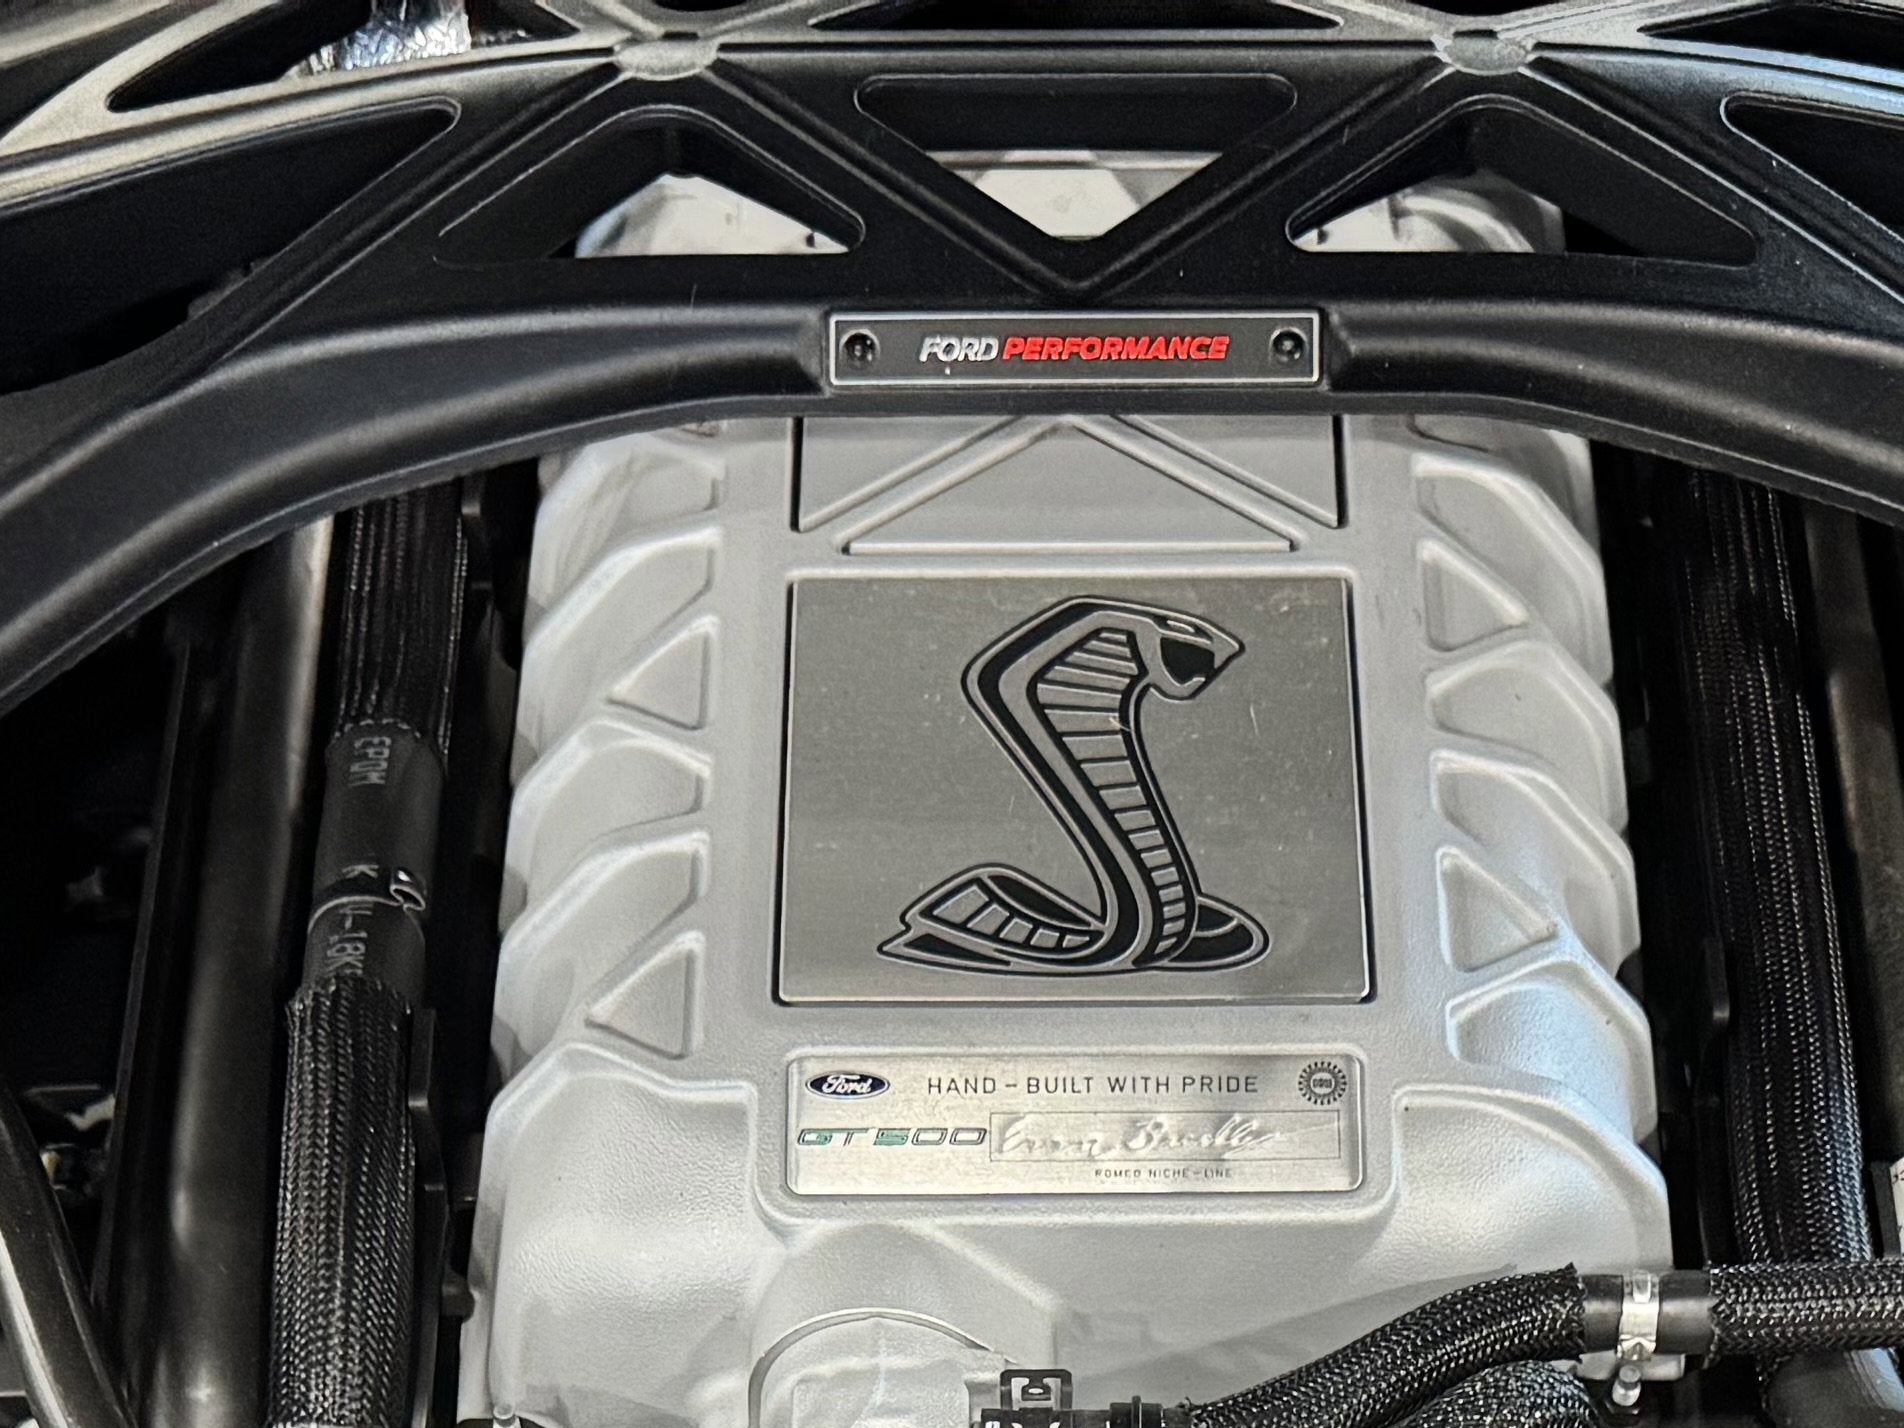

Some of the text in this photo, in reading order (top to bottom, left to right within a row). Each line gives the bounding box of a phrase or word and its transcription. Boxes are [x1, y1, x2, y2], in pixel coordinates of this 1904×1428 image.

[919, 335, 1231, 362] FORD PERFORMANCE
[1107, 1076, 1171, 1094] WITH
[1182, 1075, 1259, 1094] PRIDE
